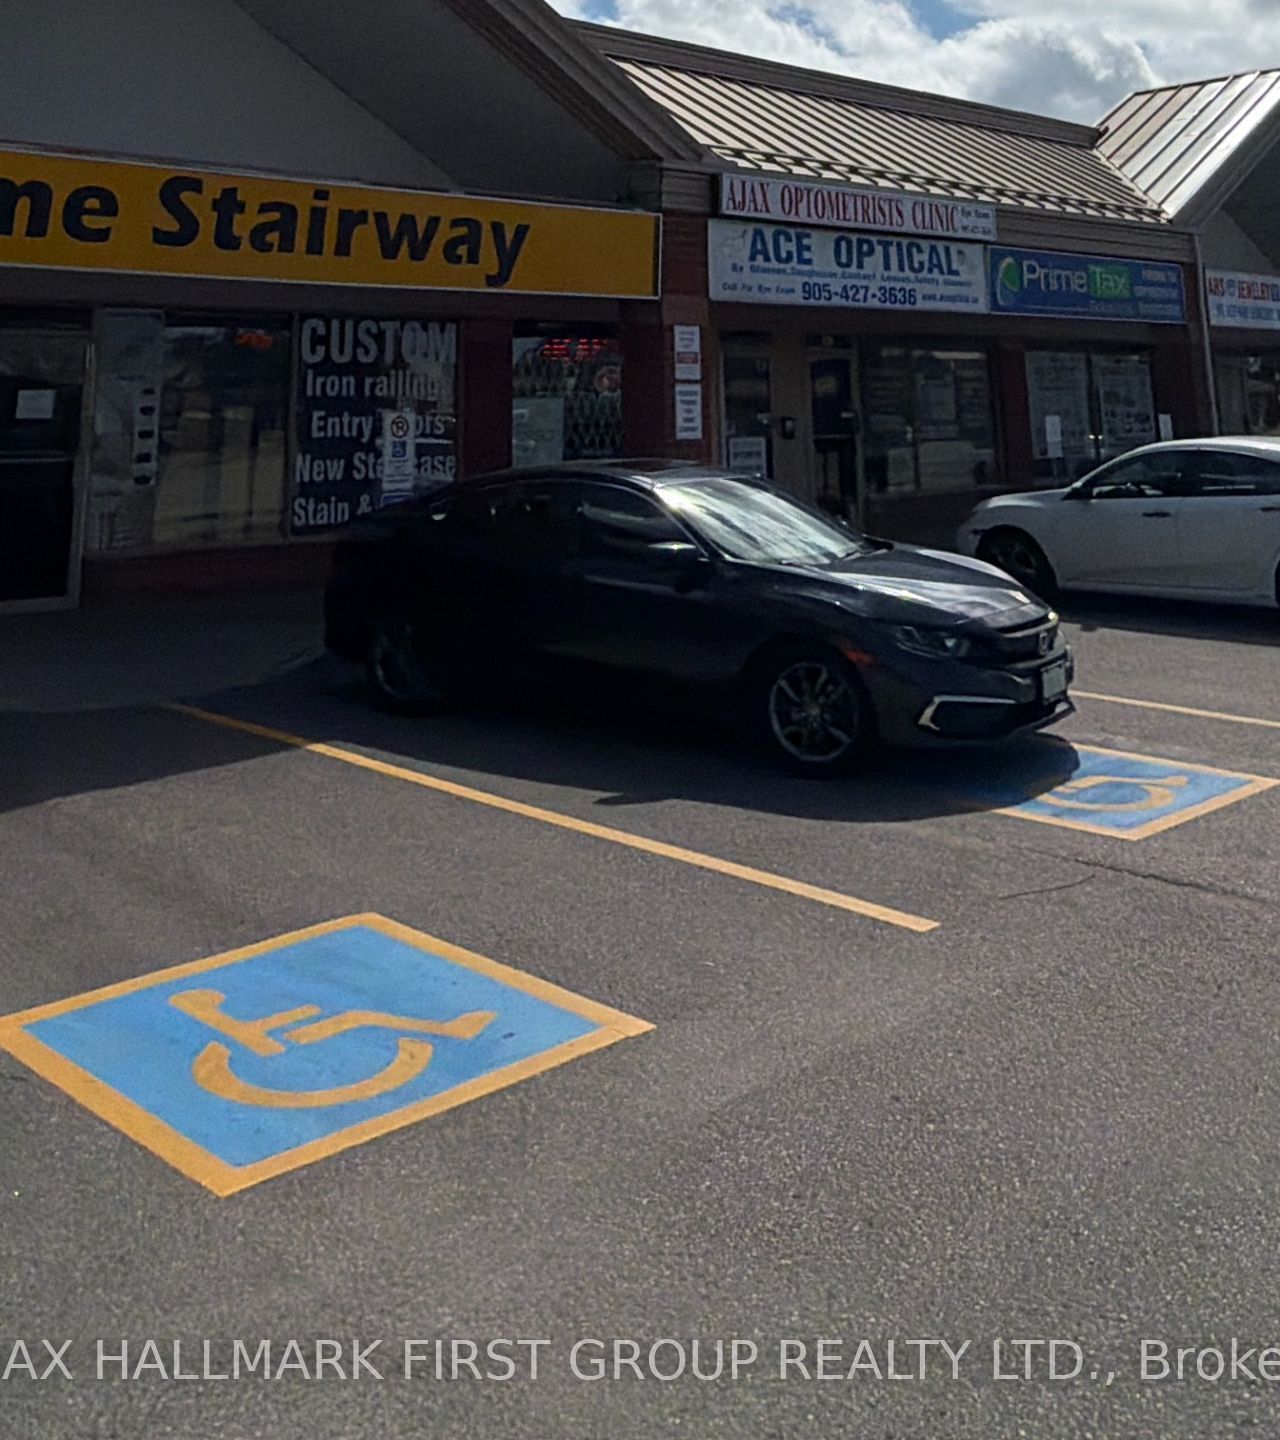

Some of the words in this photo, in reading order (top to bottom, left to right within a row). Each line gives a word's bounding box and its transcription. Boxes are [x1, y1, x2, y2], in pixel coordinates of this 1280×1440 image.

[726, 177, 770, 213] AJAX
[780, 184, 905, 227] OPTOMETRISTS
[911, 200, 959, 233] CLINIC
[152, 175, 531, 287] Stairway
[748, 227, 813, 266] ACE
[834, 234, 960, 277] OPTICAL
[801, 281, 917, 306] 905-427-3636
[1022, 259, 1088, 294] Prime
[1090, 264, 1126, 296] Tax
[301, 318, 457, 366] CUSTOM
[306, 368, 356, 398] Iron
[311, 410, 373, 444] Entry
[295, 452, 344, 483] New
[293, 496, 349, 527] Stain
